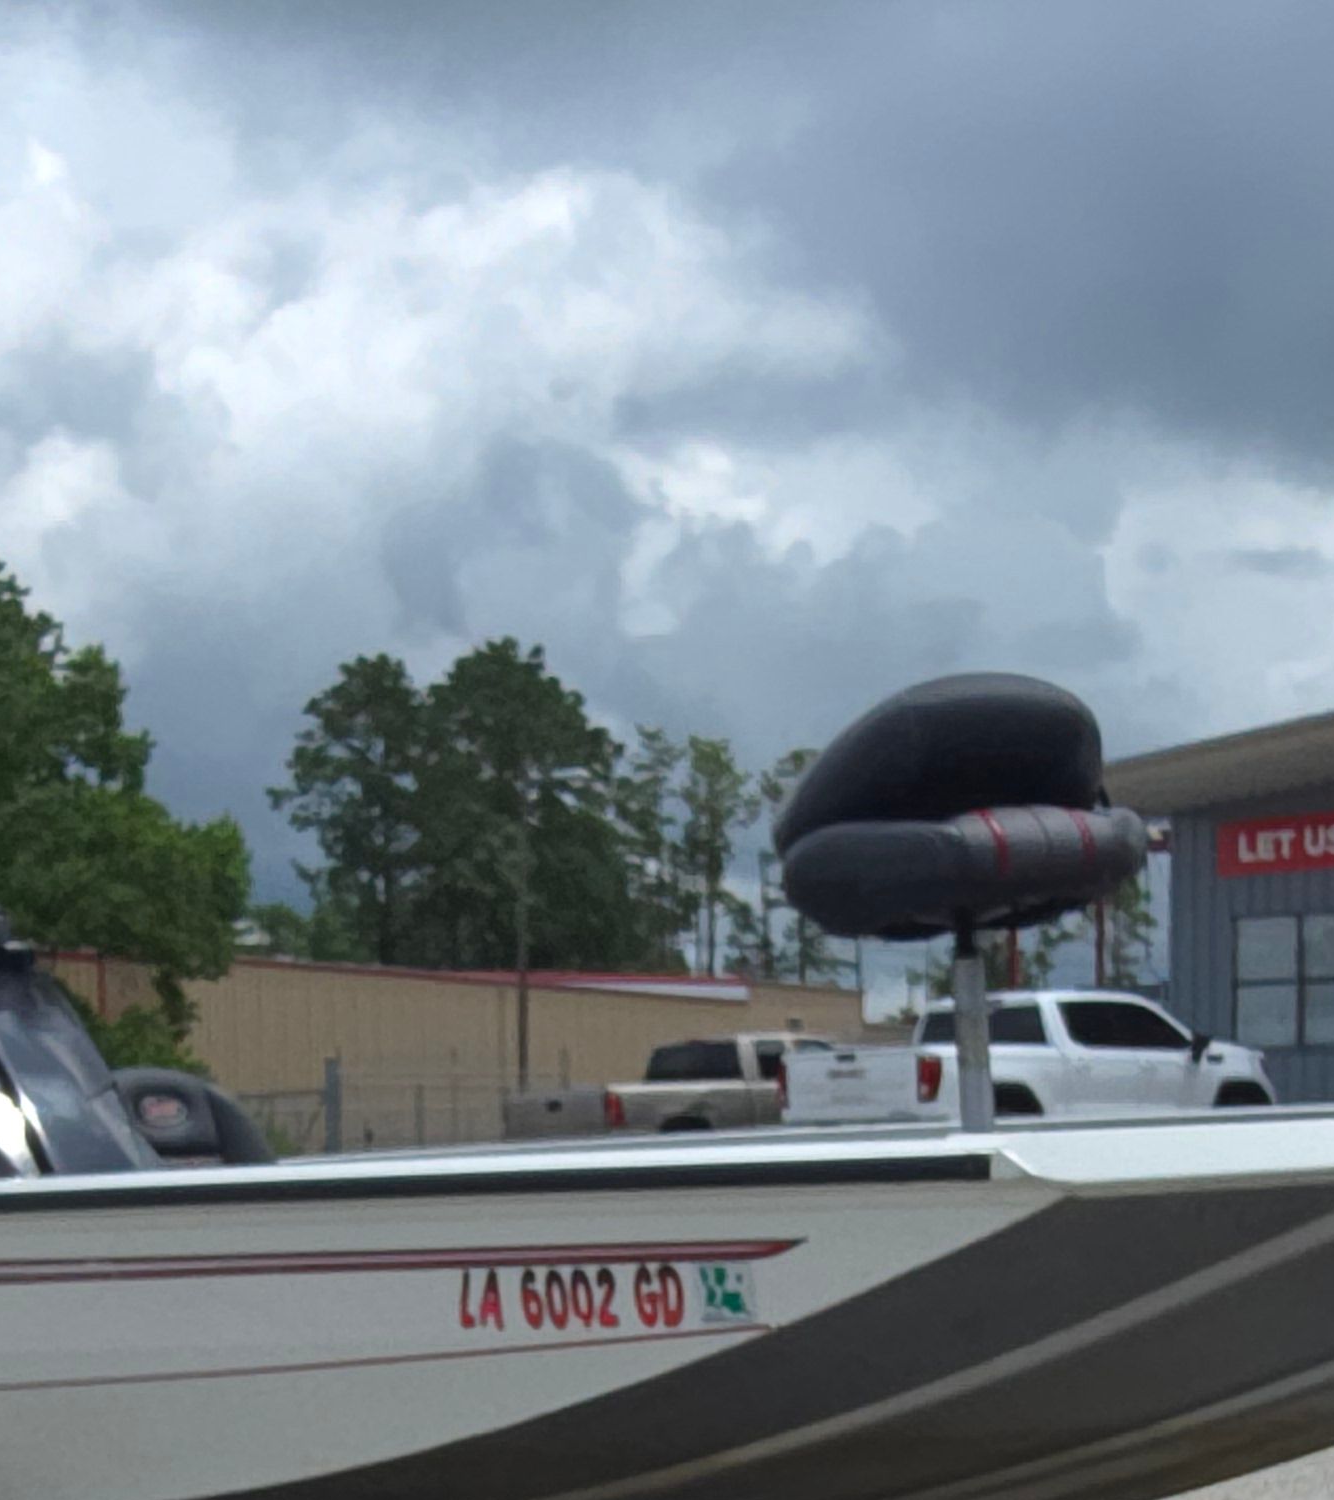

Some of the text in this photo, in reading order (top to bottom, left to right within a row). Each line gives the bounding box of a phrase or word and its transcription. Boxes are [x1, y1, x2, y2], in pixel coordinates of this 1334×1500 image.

[1237, 830, 1294, 863] LET
[458, 1263, 685, 1331] LA 6002 GD
